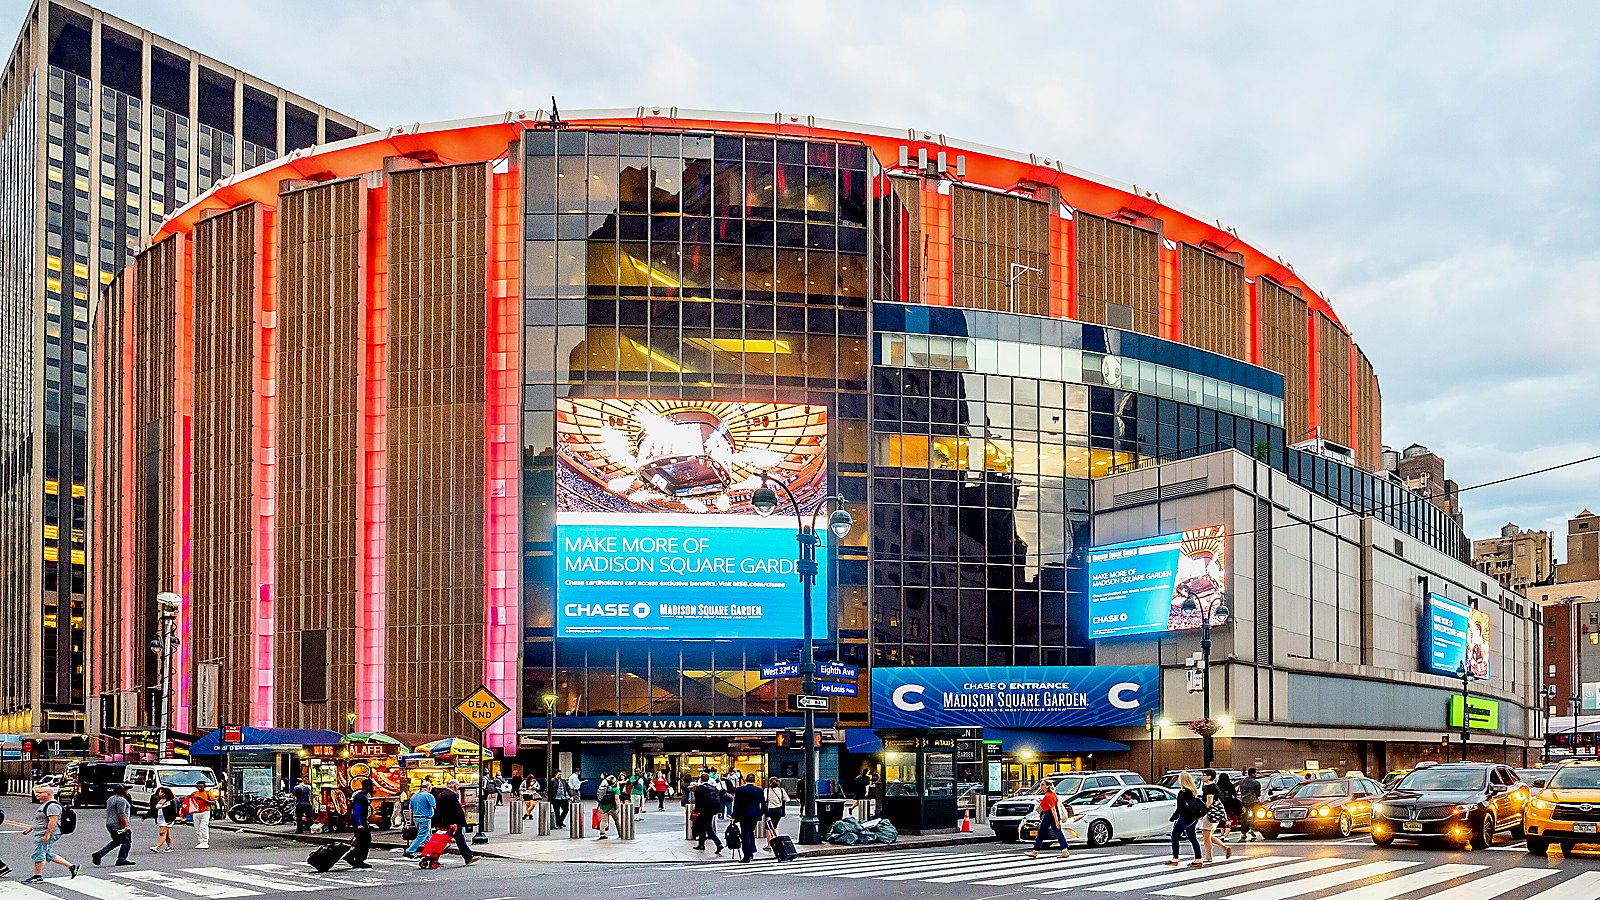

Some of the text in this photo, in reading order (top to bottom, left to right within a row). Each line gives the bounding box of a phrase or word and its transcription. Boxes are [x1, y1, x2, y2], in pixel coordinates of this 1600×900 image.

[565, 537, 710, 554] MAKE MORE OF
[565, 556, 801, 576] MADISON SQUARE GARDE
[1092, 568, 1137, 581] MAKE MORE OF
[1092, 570, 1172, 587] MADISON SQUARE GARDEN
[564, 603, 630, 617] CHASE
[660, 603, 696, 615] MADISON
[698, 603, 729, 616] SQUARE
[1092, 614, 1120, 625] CHASE
[764, 667, 778, 676] West
[779, 666, 791, 675] 33rd
[820, 666, 855, 676] Eighth Ave
[821, 684, 831, 693] Joe
[831, 685, 845, 693] Louis
[963, 682, 996, 690] CHASE
[468, 701, 496, 709] DEAD
[943, 692, 994, 708] MADISON
[997, 692, 1040, 708] SQUARE
[598, 720, 763, 729] PENNSYLVANIA STATION
[346, 745, 386, 755] ALAFEL
